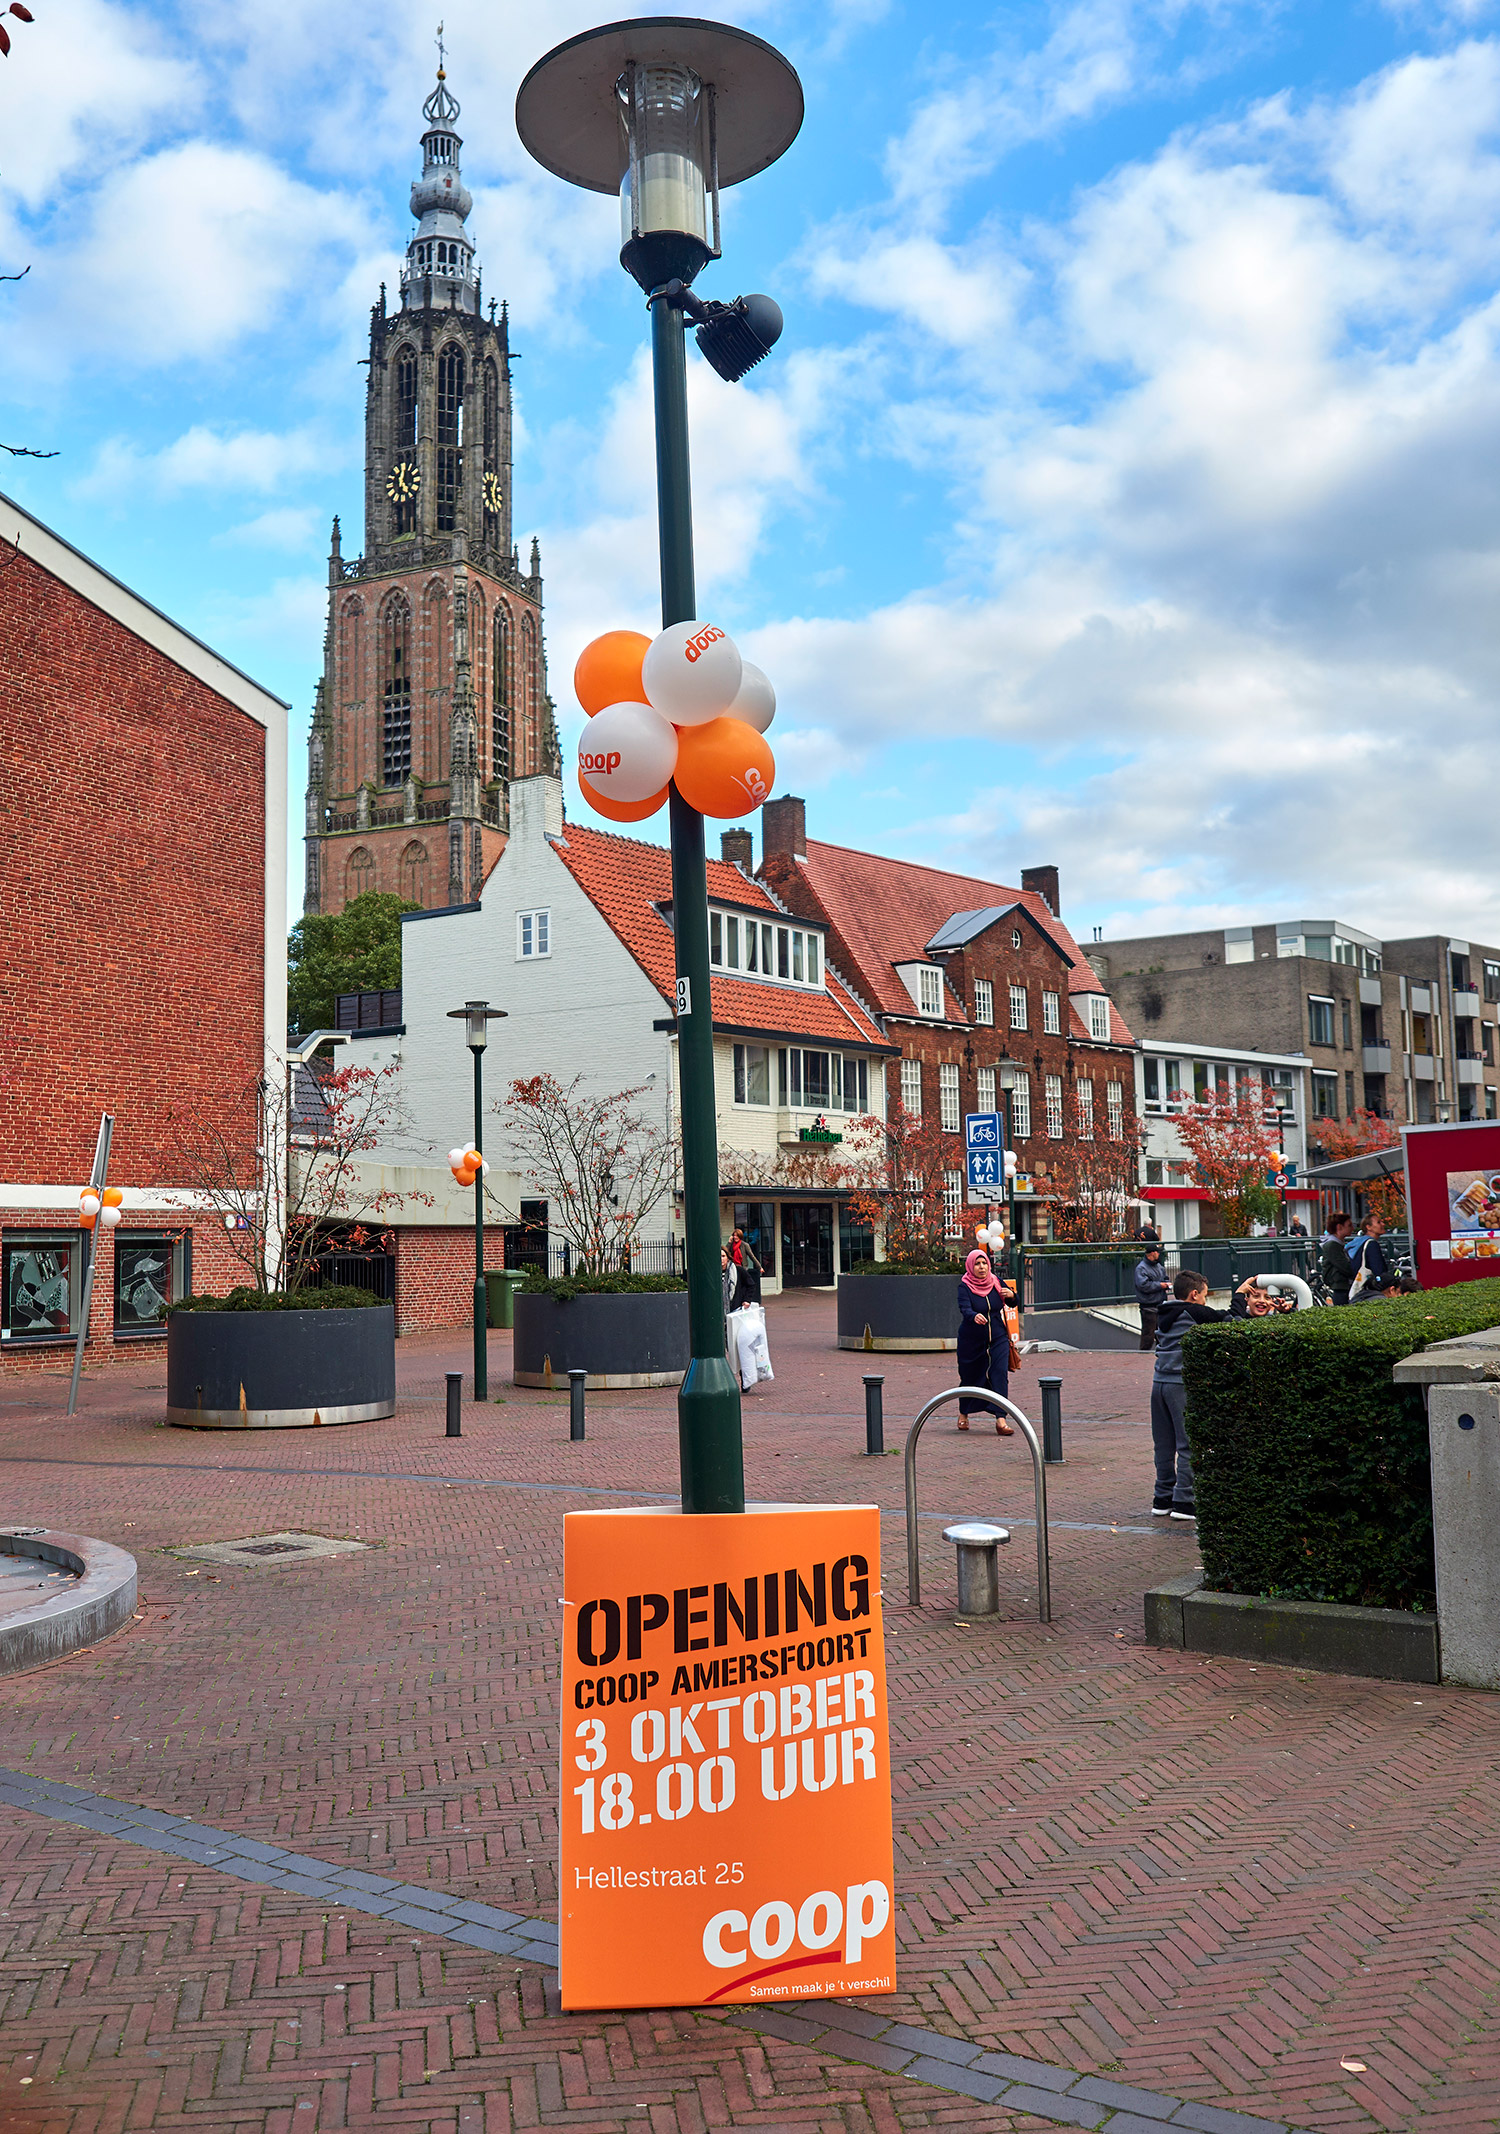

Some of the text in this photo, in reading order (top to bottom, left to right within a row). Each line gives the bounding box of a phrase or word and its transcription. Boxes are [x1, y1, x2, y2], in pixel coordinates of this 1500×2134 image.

[685, 627, 726, 663] coop
[579, 751, 621, 774] coop
[678, 981, 687, 1012] 09
[975, 1174, 994, 1183] WC
[577, 1554, 870, 1667] OPENING
[575, 1628, 872, 1710] COOP AMERSFOORT
[575, 1669, 876, 1772] 3 OKTOBER
[573, 1727, 877, 1834] 18.00 UUR
[574, 1862, 745, 1889] Hellestraat 25
[702, 1879, 890, 1968] coop
[750, 1985, 789, 1997] Samen
[791, 1981, 823, 1994] maak
[824, 1981, 835, 1994] je
[847, 1976, 890, 1990] verschil
